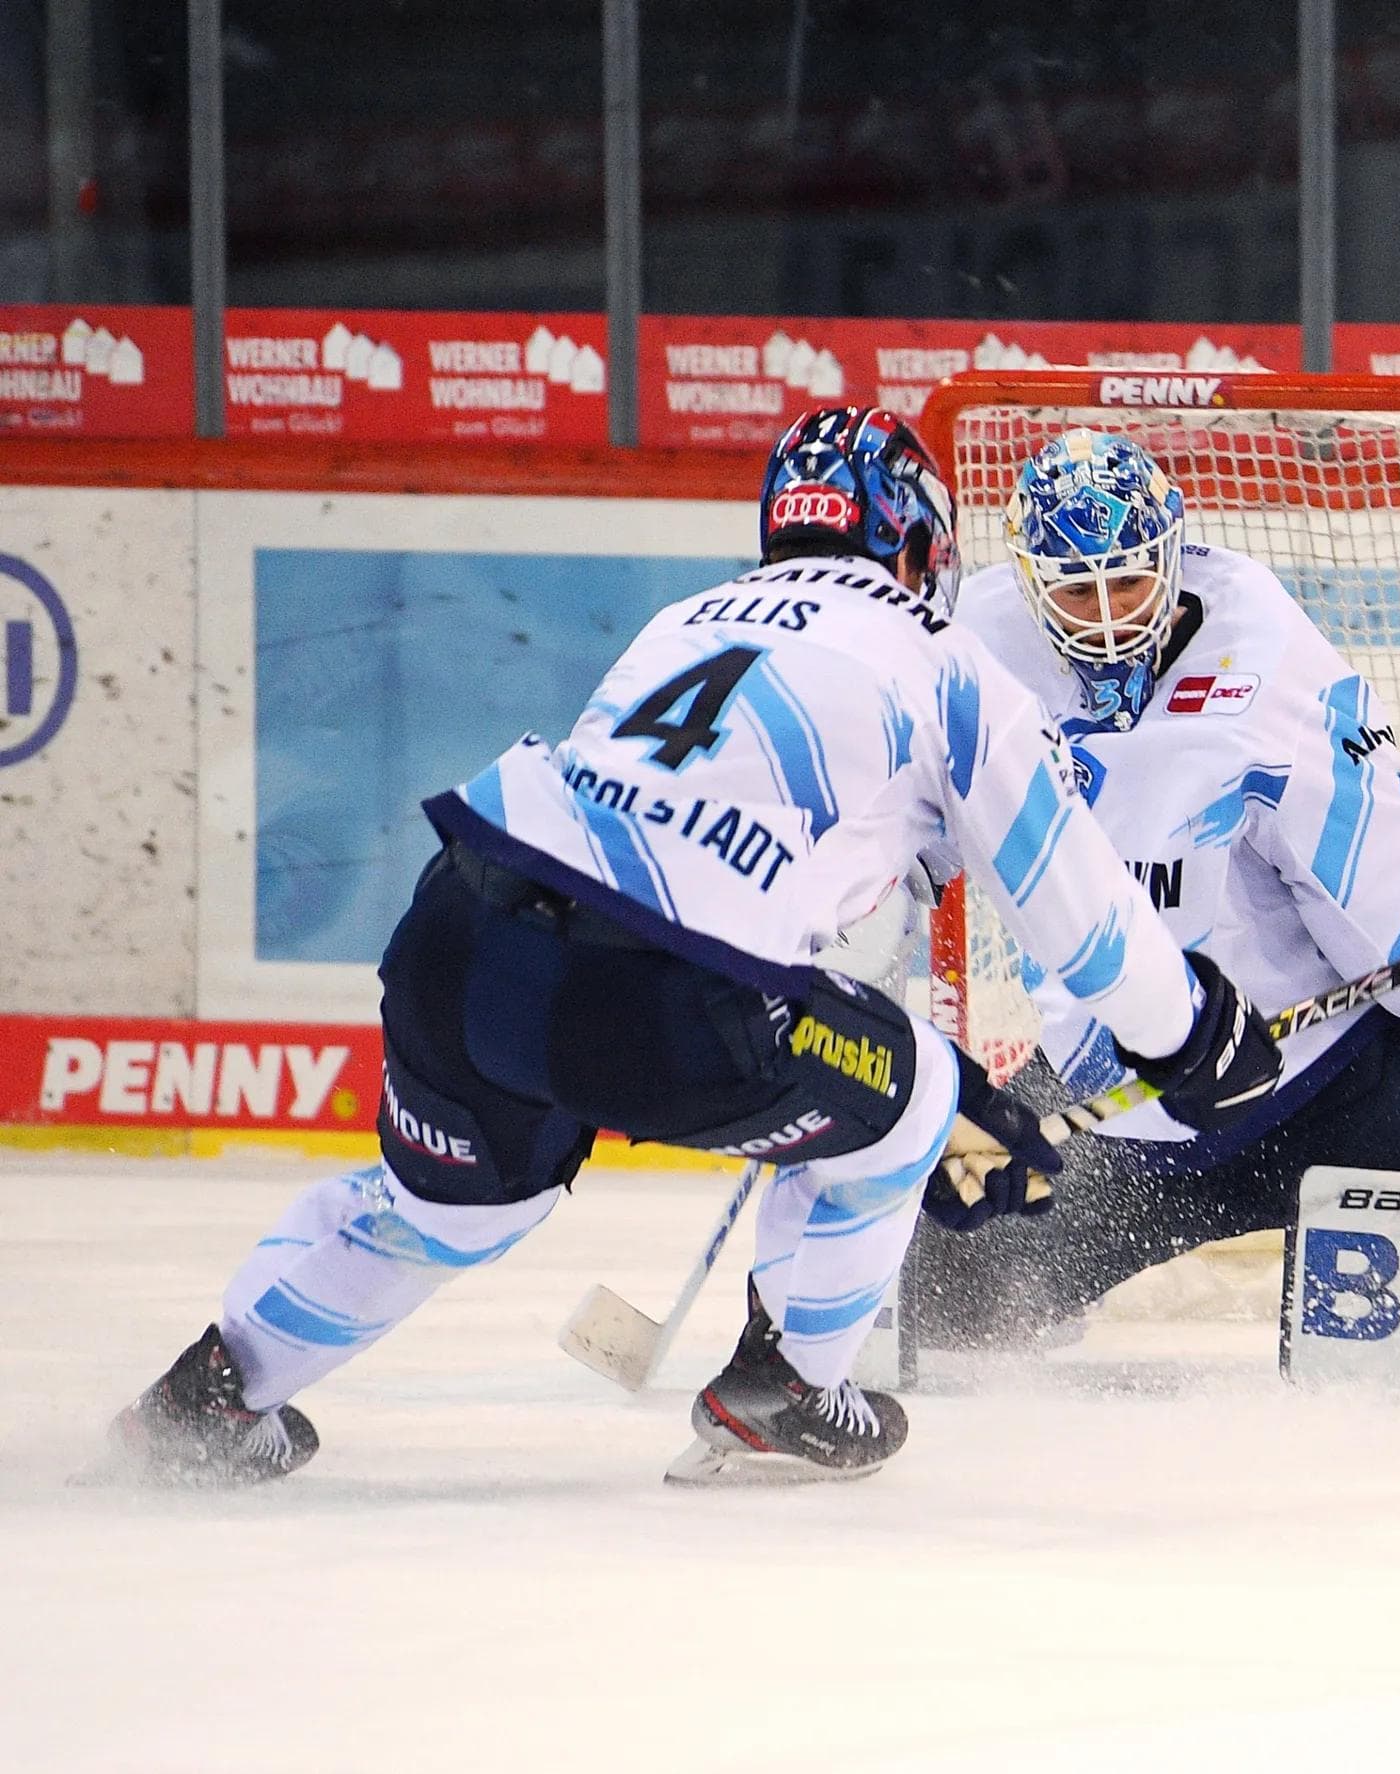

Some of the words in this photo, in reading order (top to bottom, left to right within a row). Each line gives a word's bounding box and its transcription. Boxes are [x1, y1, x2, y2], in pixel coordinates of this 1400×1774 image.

[226, 338, 317, 369] WERNER
[428, 341, 520, 372] WERNER
[667, 345, 757, 377] WERNER
[226, 373, 342, 406] WOHNBAU
[428, 377, 545, 410] WOHNBAU
[666, 380, 783, 415] WOHNBAU
[683, 597, 821, 631] ELLIS
[609, 640, 768, 774] 4
[1286, 964, 1394, 1035] TACKS
